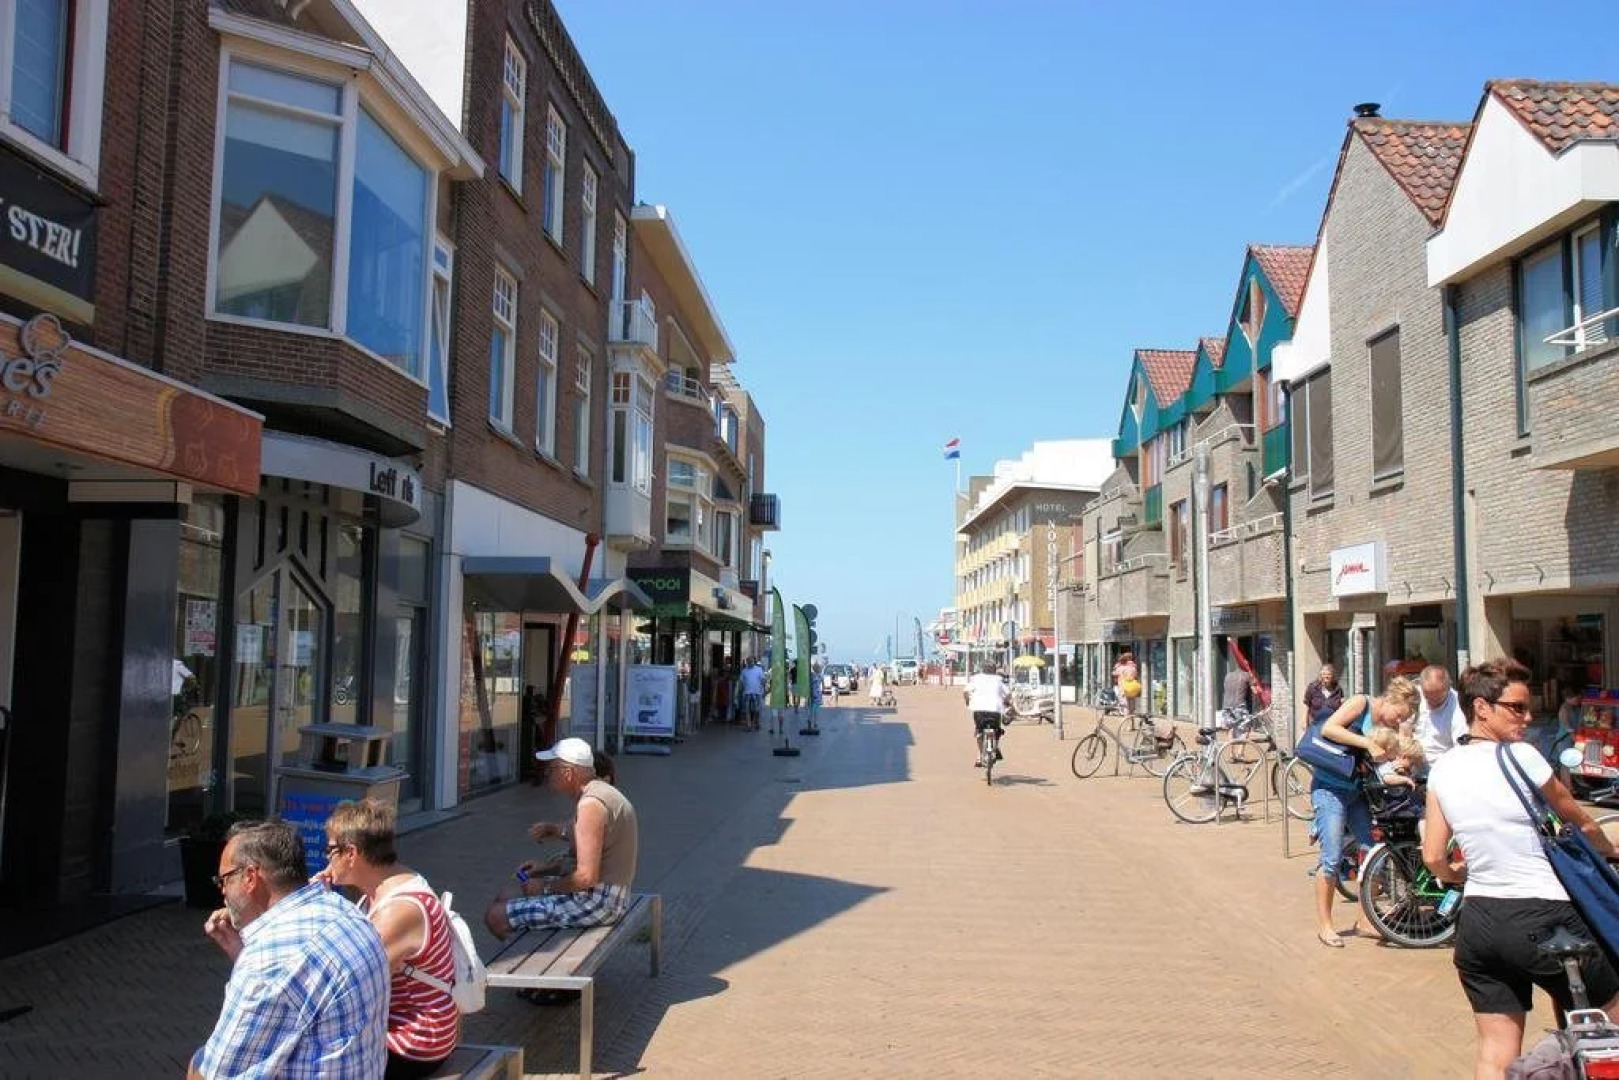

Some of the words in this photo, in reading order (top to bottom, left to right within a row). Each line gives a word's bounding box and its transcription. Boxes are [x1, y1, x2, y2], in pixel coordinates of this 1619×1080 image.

[7, 204, 82, 268] STER!
[0, 349, 58, 398] es
[1035, 503, 1065, 512] HOTEL
